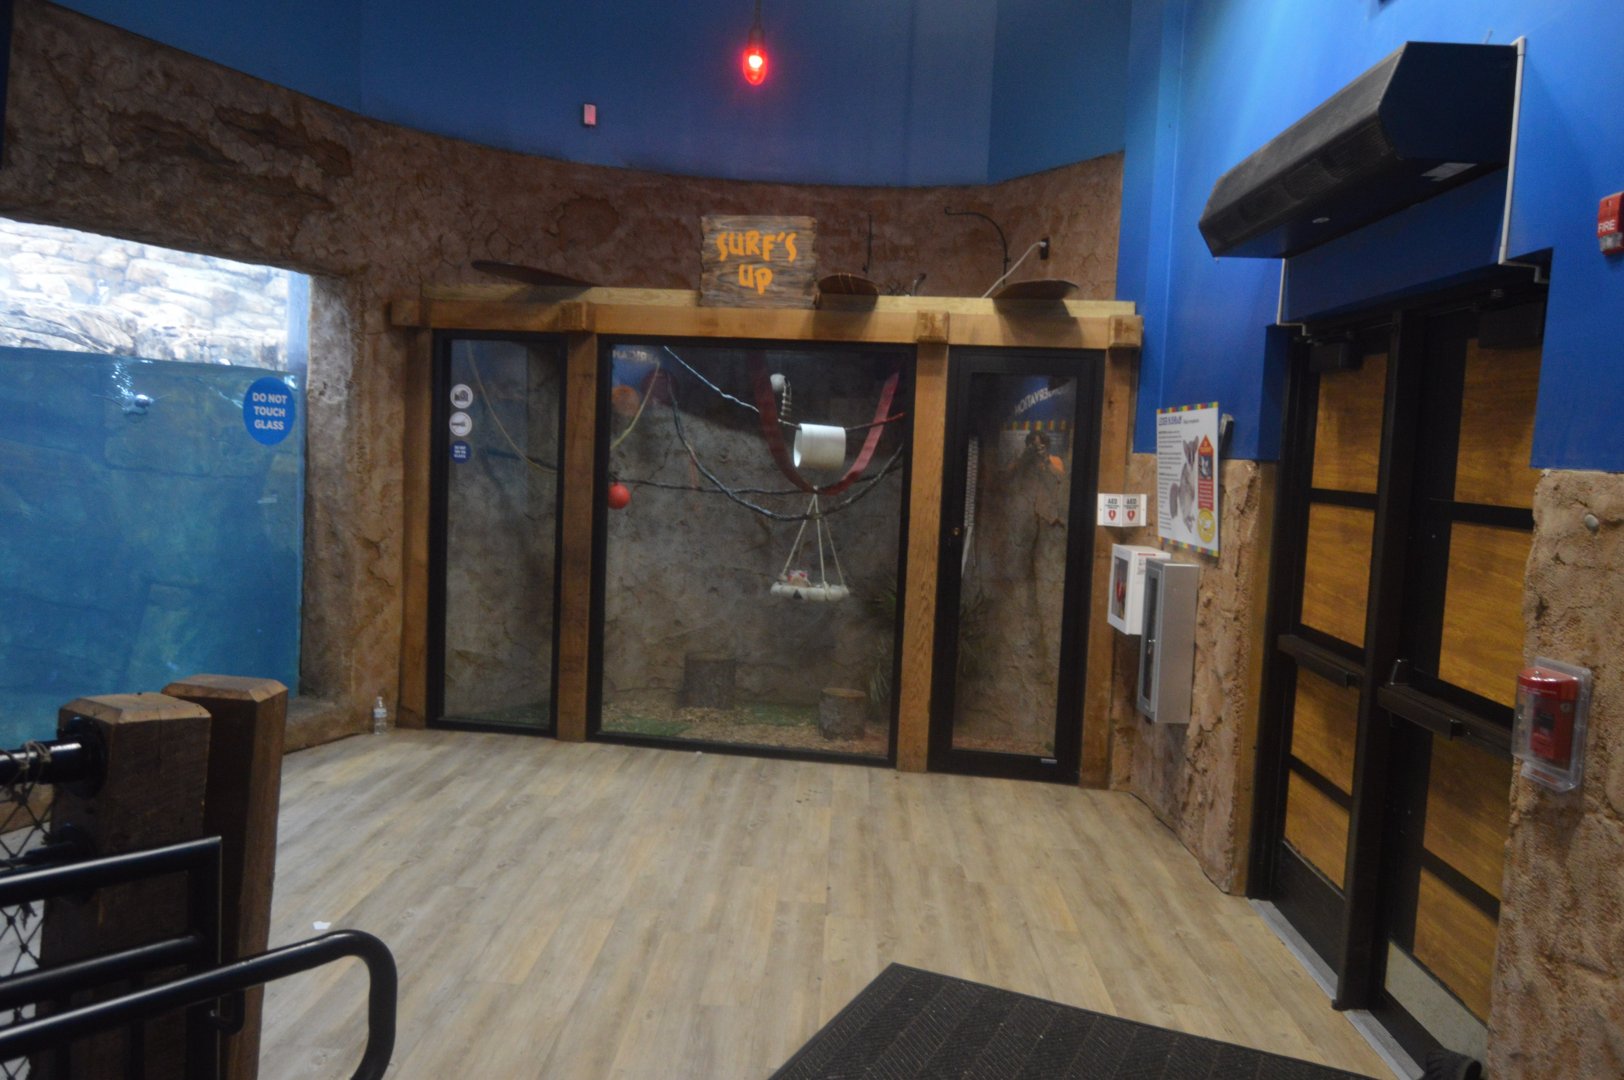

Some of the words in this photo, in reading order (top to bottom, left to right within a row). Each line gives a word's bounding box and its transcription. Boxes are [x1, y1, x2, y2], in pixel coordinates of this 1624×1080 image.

[1597, 219, 1616, 233] FIRE
[716, 230, 798, 262] SURF'S
[738, 264, 774, 296] UP
[252, 392, 267, 402] DO
[268, 393, 288, 404] NOT
[254, 405, 286, 417] TOUCH
[254, 419, 285, 430] GLASS
